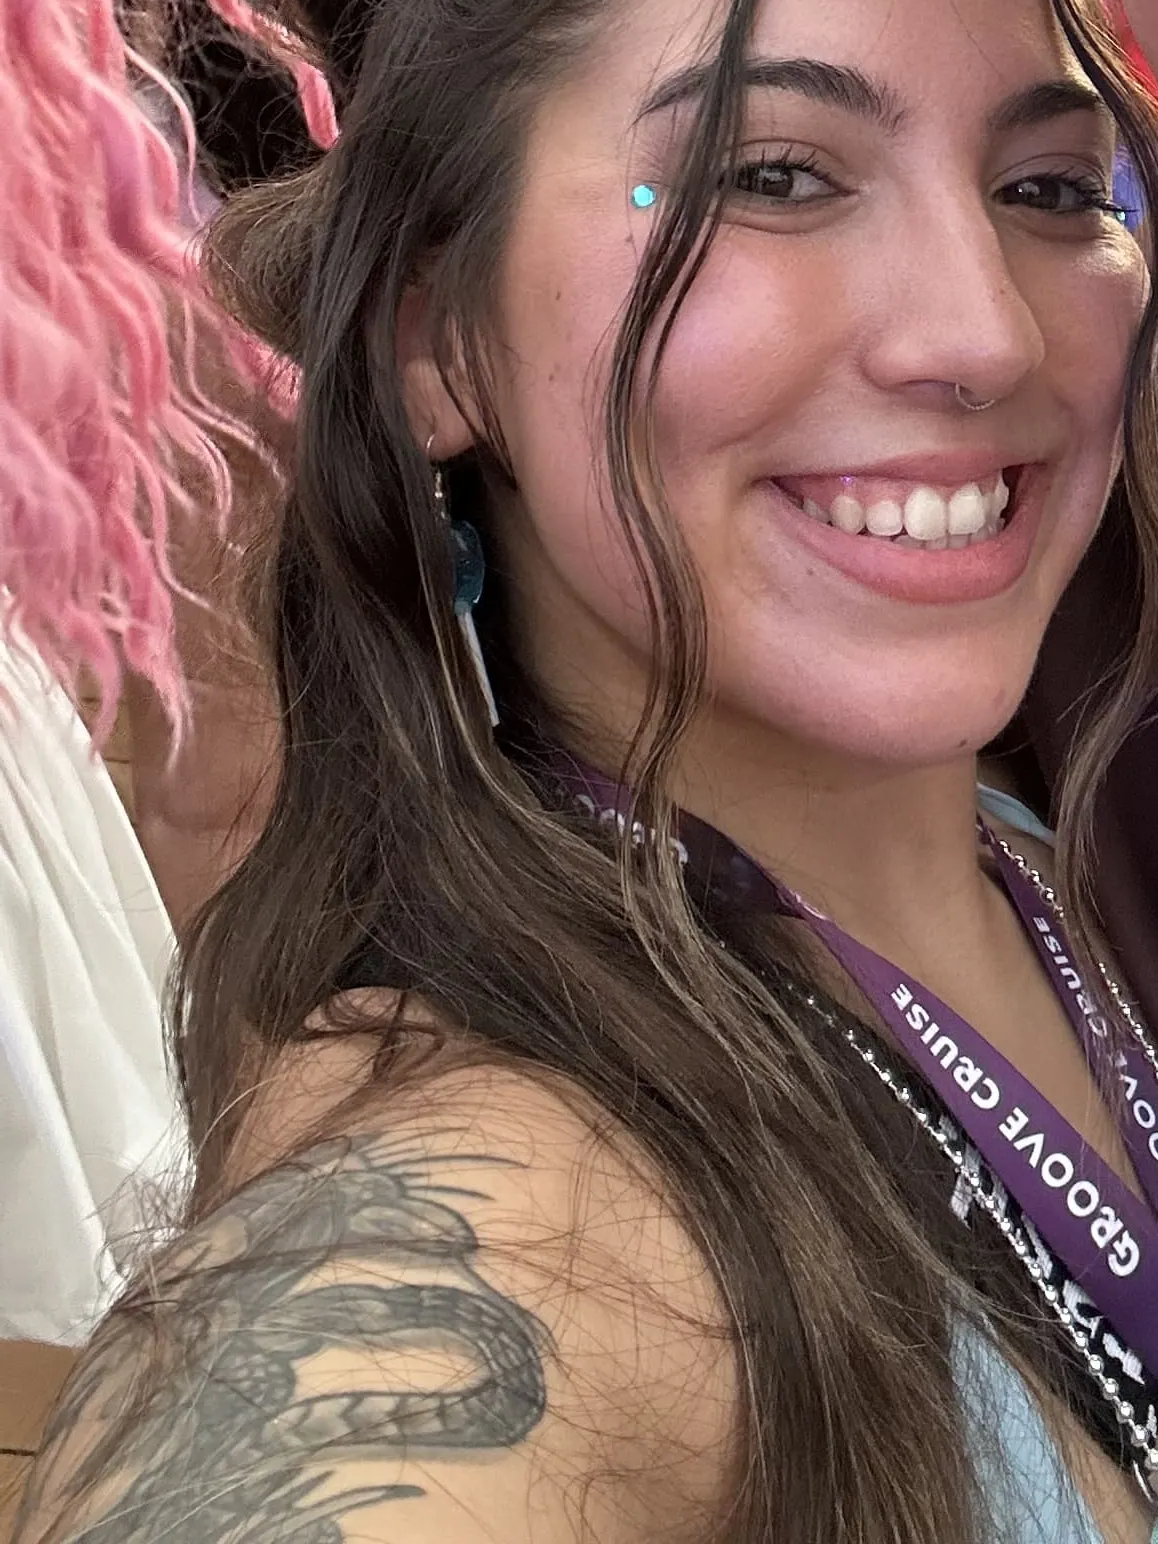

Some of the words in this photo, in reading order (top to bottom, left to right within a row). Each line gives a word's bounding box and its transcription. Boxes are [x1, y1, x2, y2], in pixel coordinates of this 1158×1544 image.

[1032, 915, 1110, 1039] CRUISE
[890, 982, 1000, 1112] CRUISE
[998, 1106, 1141, 1278] GROOVE
